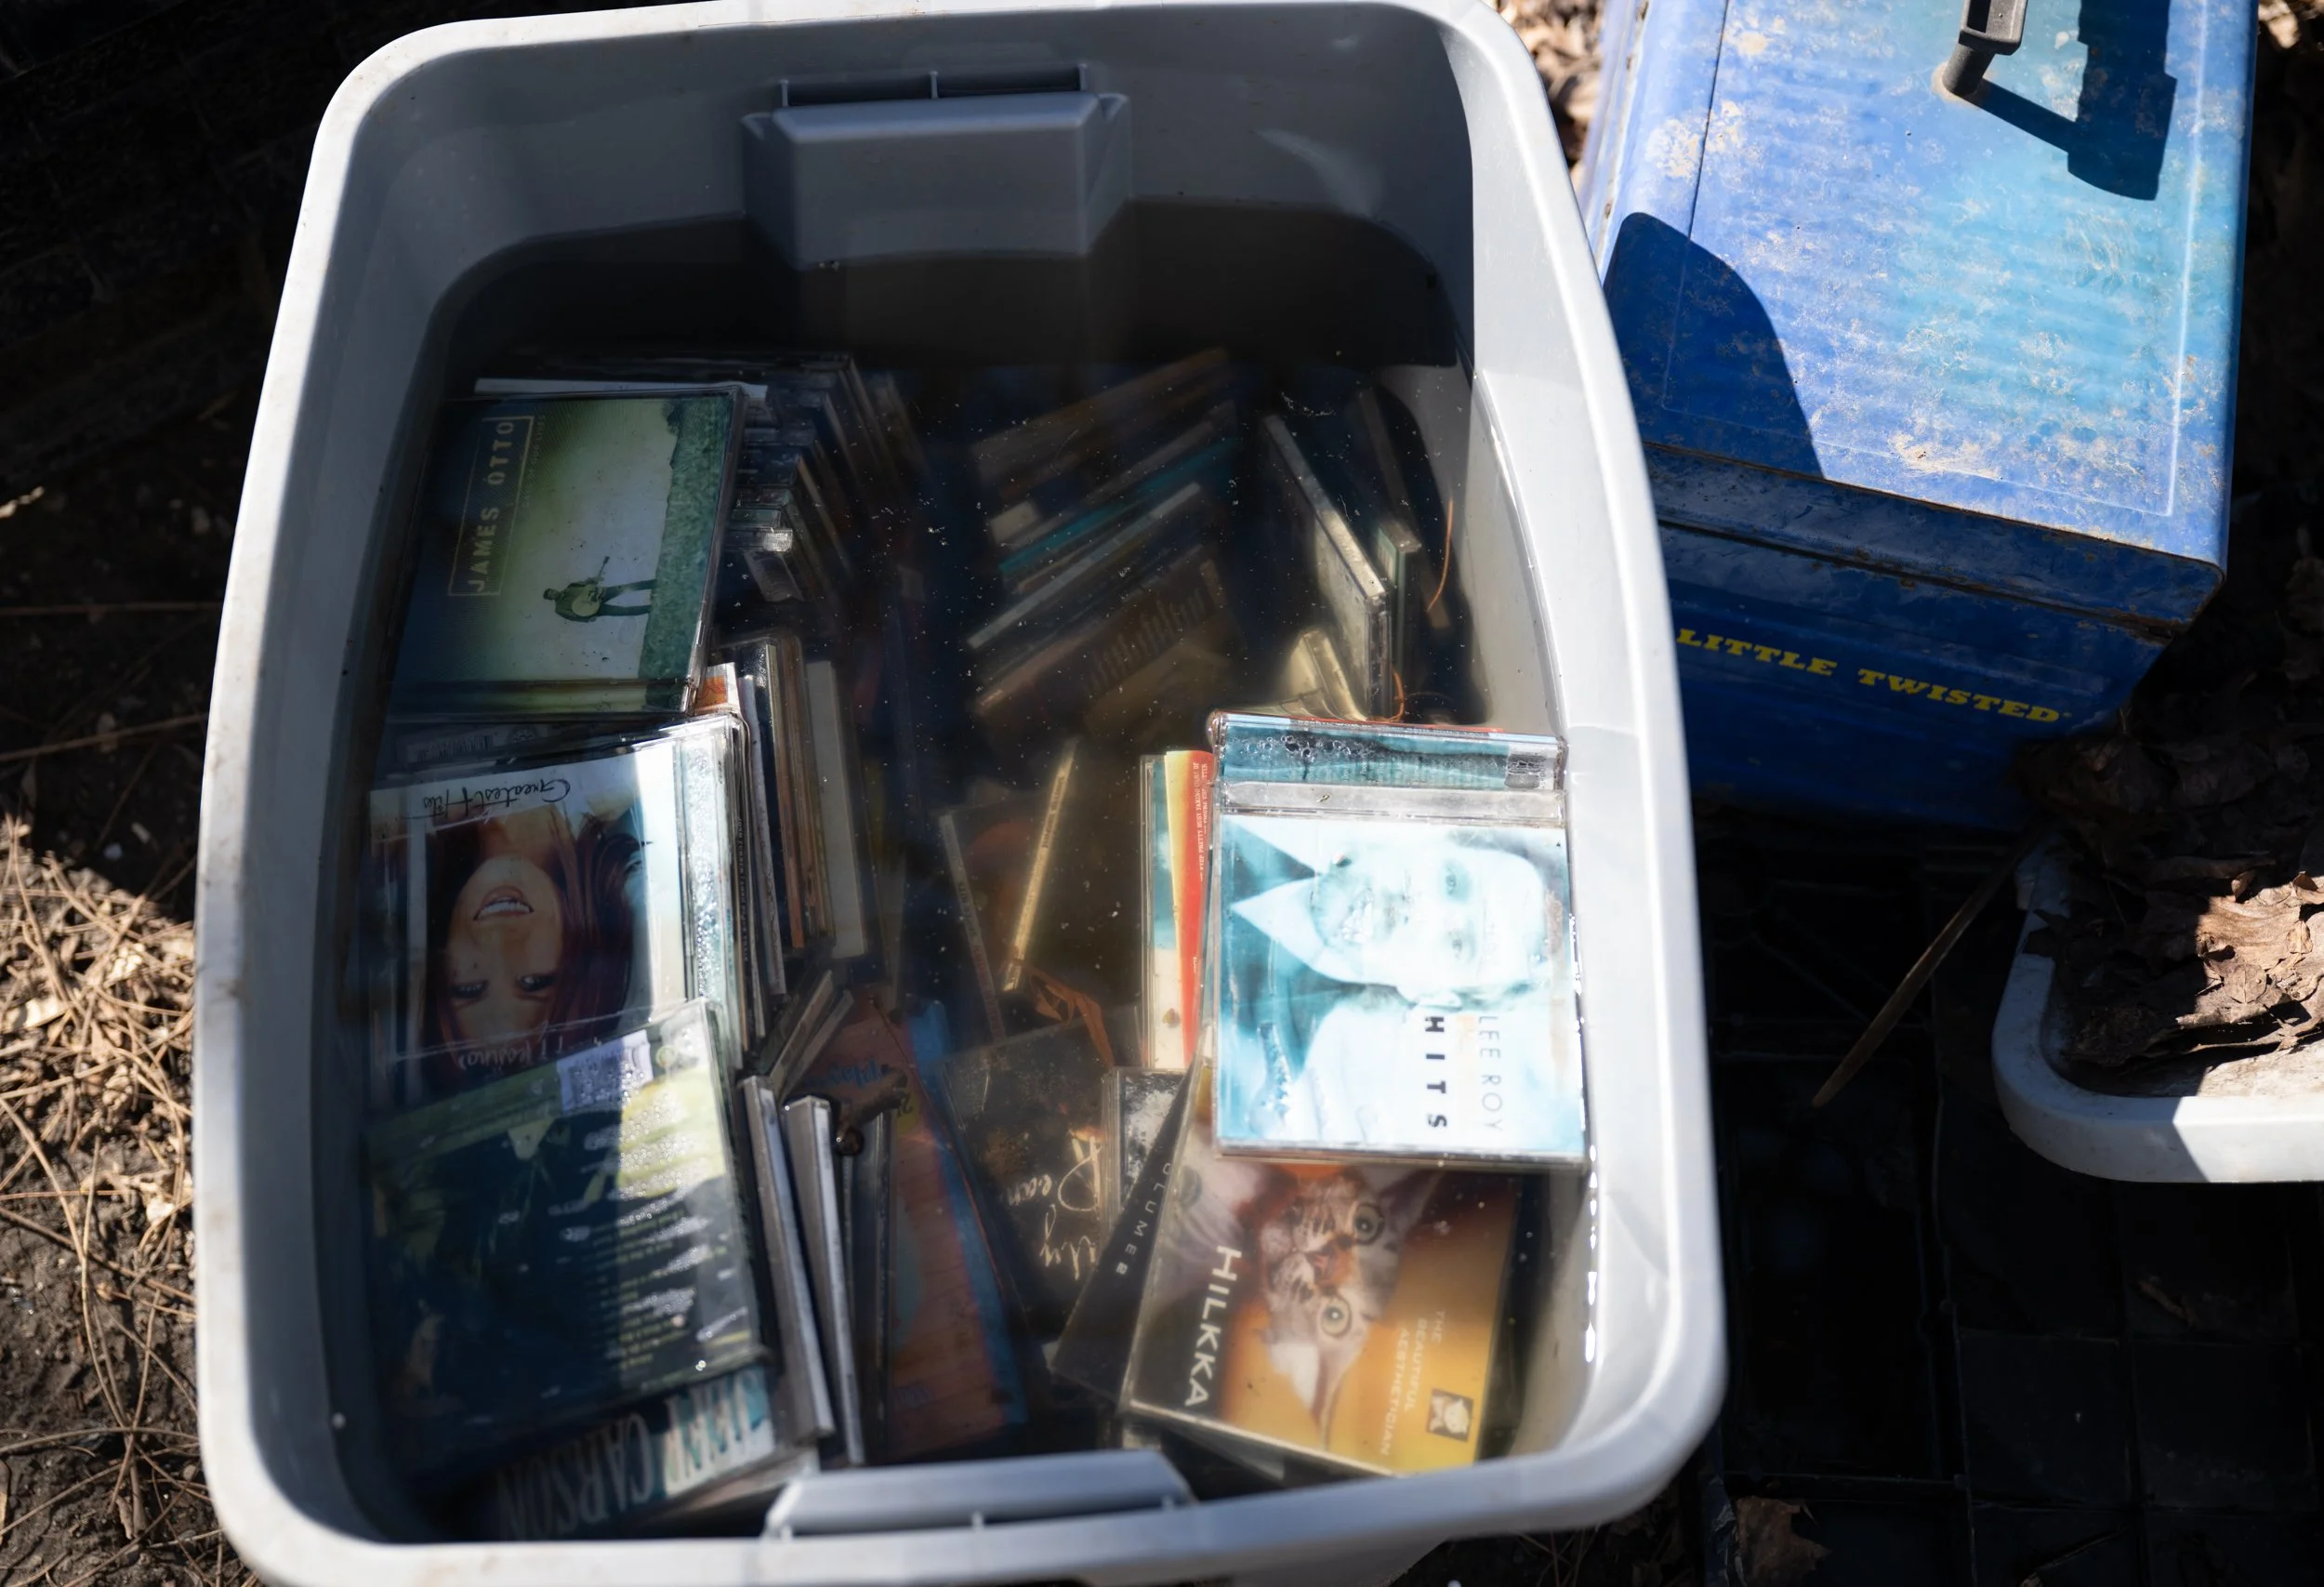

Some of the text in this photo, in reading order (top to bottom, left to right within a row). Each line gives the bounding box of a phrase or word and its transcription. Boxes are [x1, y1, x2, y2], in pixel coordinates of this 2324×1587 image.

[468, 421, 514, 593] JAMES OTTO
[1676, 629, 2060, 722] LITTLE TWISTED
[412, 778, 571, 820] Greatest Hits
[1425, 1015, 1447, 1128] HITS
[1479, 1016, 1503, 1132] LEE ROY
[1125, 1162, 1170, 1255] OLUME
[1185, 1245, 1242, 1408] HILKKA
[1403, 1317, 1426, 1413] BEAUTIFUL
[1427, 1310, 1446, 1345] THE
[496, 1413, 654, 1541] CARSON
